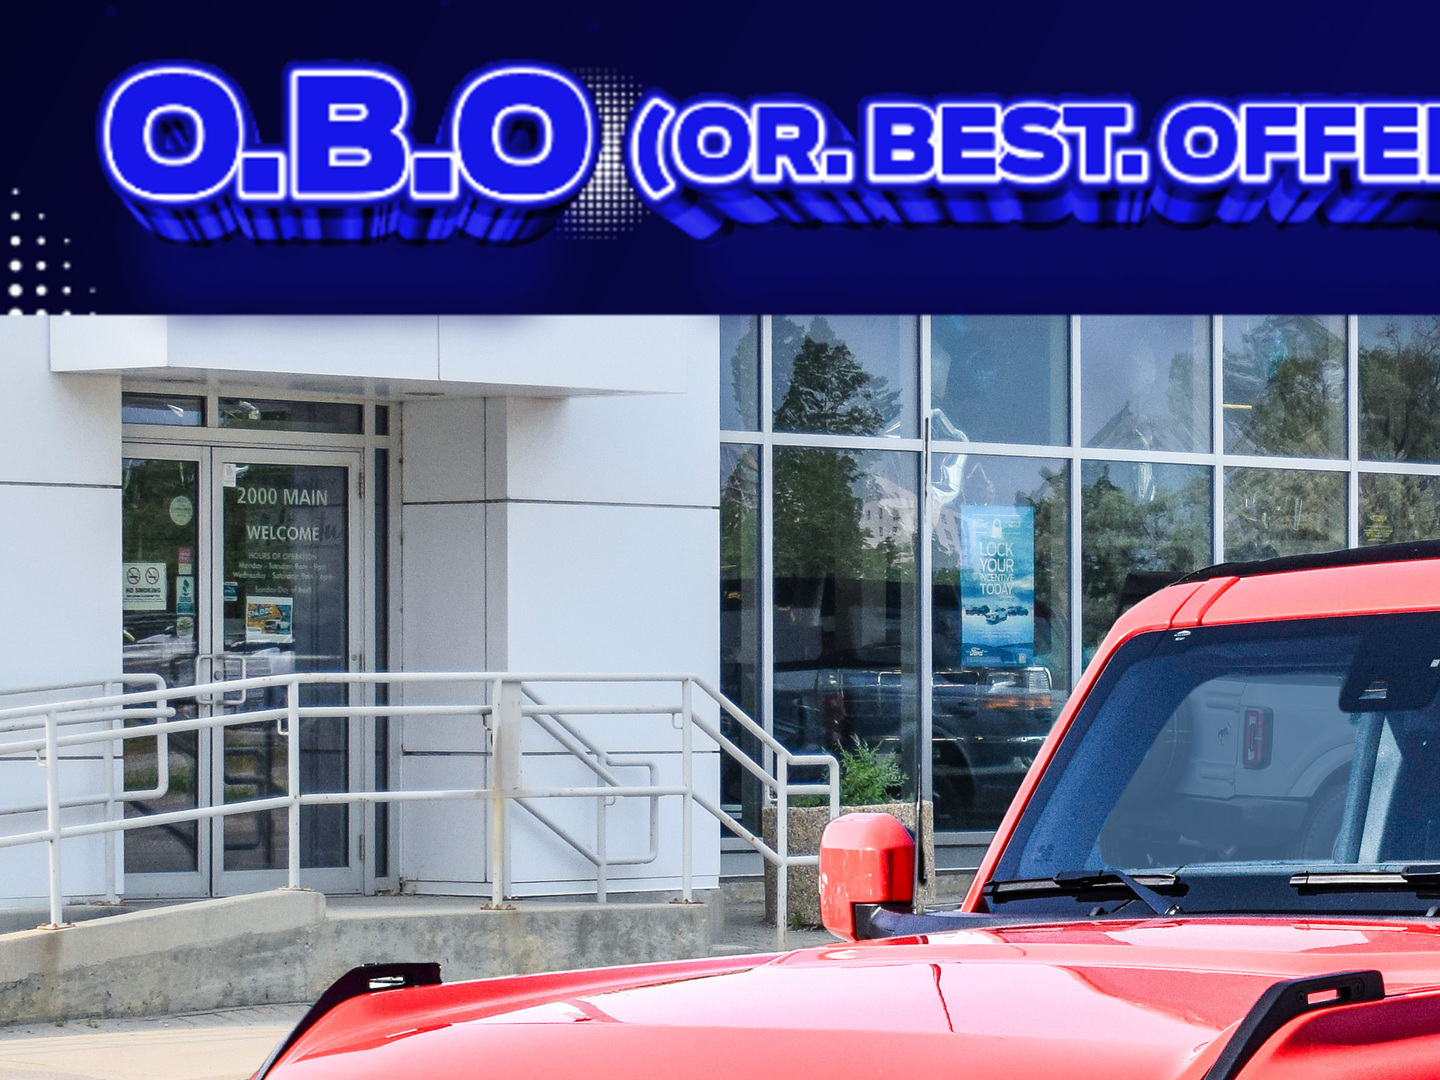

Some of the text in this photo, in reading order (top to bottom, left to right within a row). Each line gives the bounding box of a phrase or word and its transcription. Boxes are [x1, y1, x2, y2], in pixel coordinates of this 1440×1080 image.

[237, 487, 328, 506] 2000 MAIN
[246, 525, 320, 541] WELCOME
[979, 542, 1014, 557] LOCK
[979, 558, 1014, 572] YOUR
[980, 583, 1014, 595] TODAY
